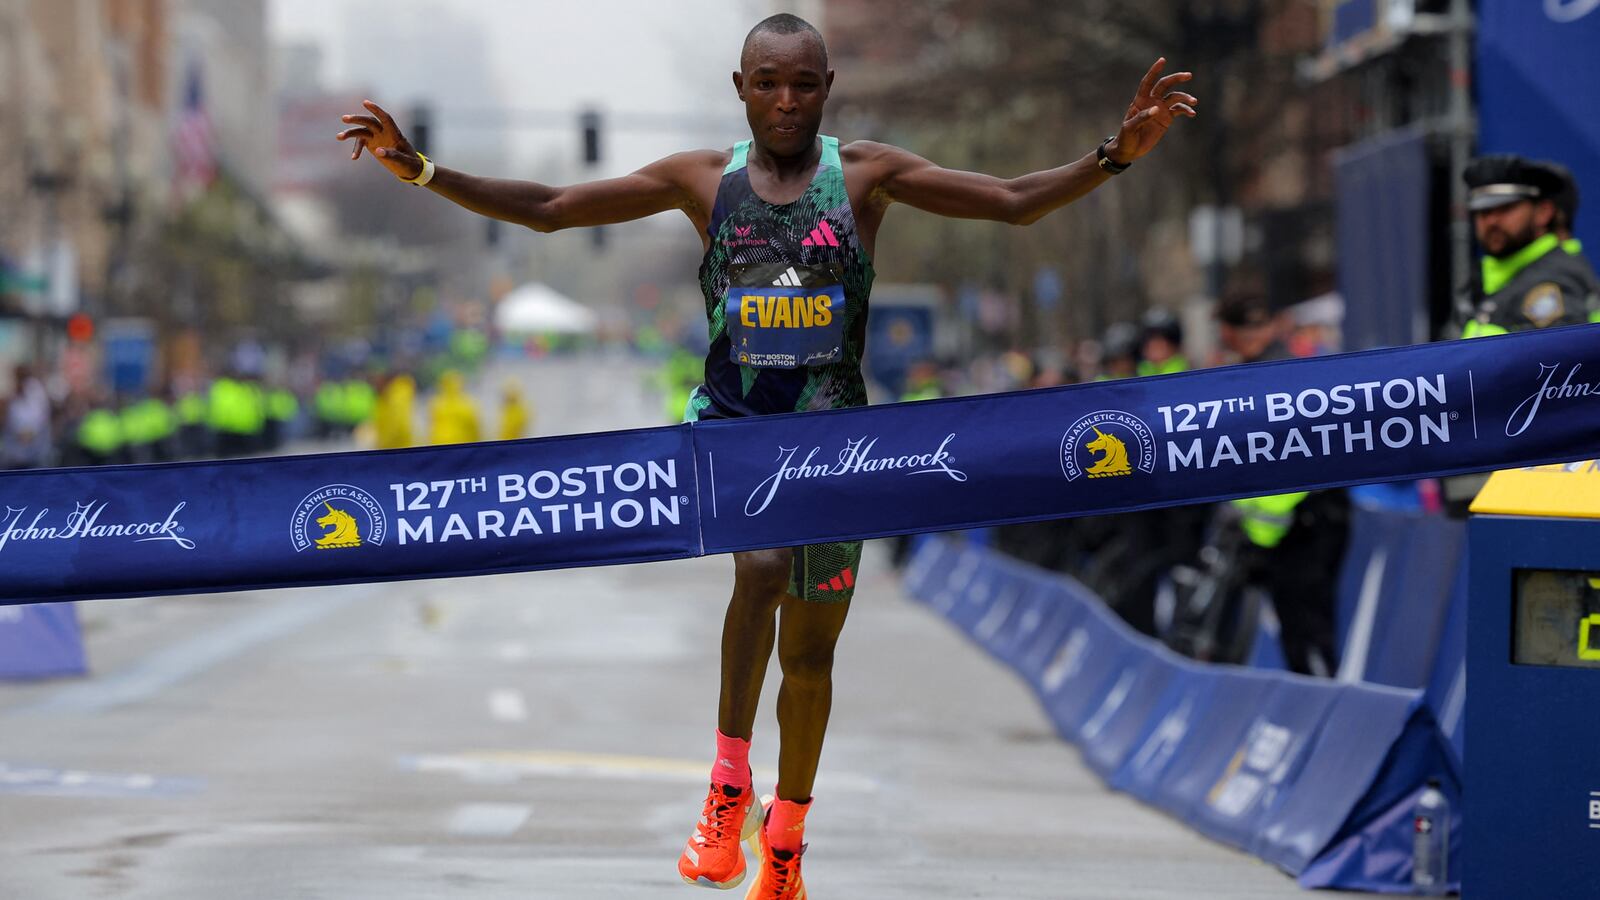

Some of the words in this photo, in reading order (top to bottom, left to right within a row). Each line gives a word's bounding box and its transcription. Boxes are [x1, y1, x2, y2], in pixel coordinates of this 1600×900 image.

[740, 294, 833, 328] EVANS
[1157, 396, 1254, 434] 127TH
[1265, 373, 1447, 423] BOSTON
[1505, 362, 1591, 437] John
[1064, 435, 1077, 477] BOSTON
[1073, 413, 1116, 436] ATHLETIC
[1117, 414, 1153, 469] ASSOCIATION
[1166, 411, 1450, 473] MARATHON
[390, 476, 487, 512] 127TH
[498, 458, 677, 503] BOSTON
[744, 444, 832, 517] John
[829, 432, 968, 482] Hancock
[0, 505, 57, 551] John
[56, 499, 196, 550] Hancock
[294, 510, 307, 548] BOSTON
[304, 488, 348, 511] ATHLETIC
[349, 490, 383, 542] ASSOCIATION
[397, 495, 681, 546] MARATHON
